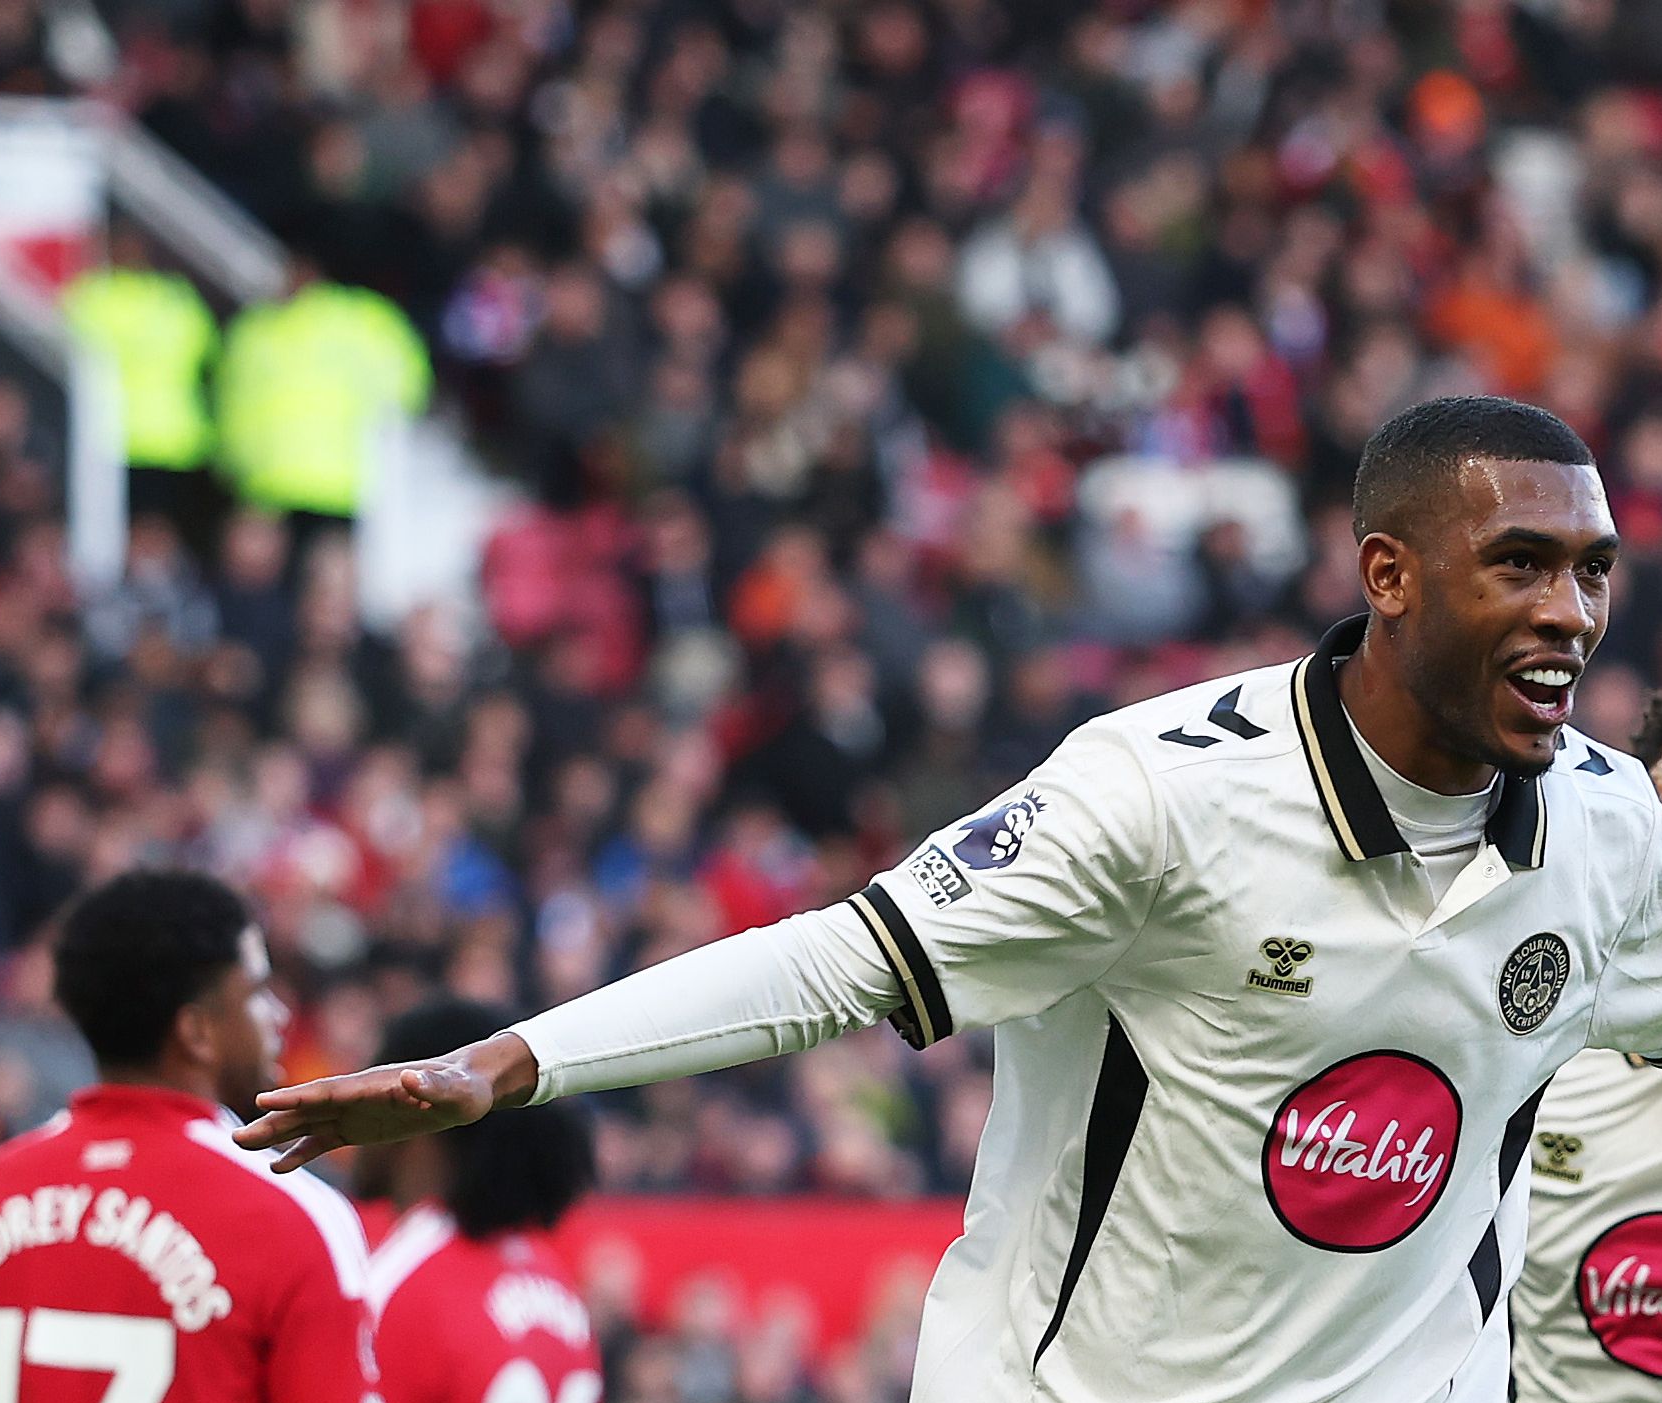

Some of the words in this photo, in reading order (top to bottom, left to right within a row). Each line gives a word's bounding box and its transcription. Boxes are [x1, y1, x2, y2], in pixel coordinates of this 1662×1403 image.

[1248, 971, 1311, 994] hummel
[1502, 962, 1517, 989] AFC
[1515, 938, 1568, 989] BOURNEMOUTH
[1520, 969, 1531, 980] 18
[1503, 1001, 1516, 1023] THE
[1515, 1002, 1553, 1027] CHERRIES
[1280, 1100, 1445, 1207] Vitality
[85, 1187, 233, 1333] SANTOS
